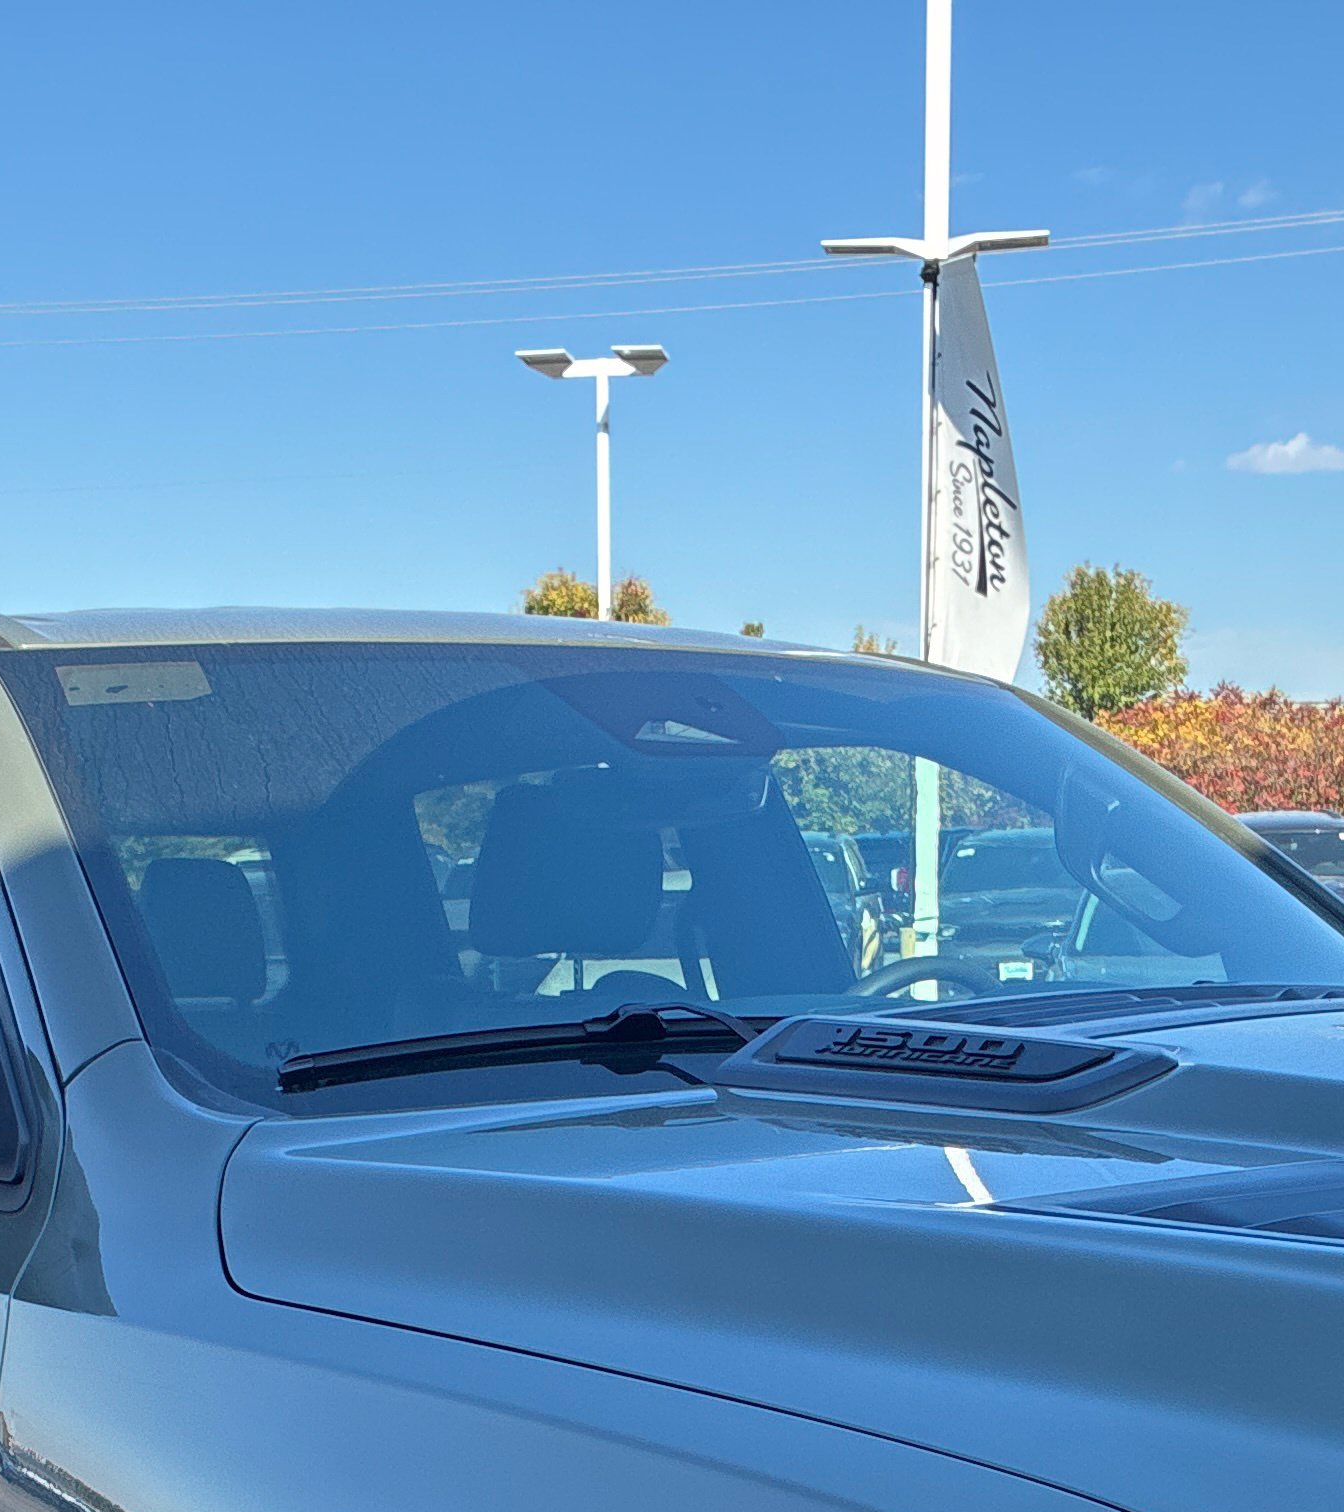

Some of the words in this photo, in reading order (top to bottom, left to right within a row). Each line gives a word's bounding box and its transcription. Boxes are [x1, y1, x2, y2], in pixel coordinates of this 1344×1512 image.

[949, 461, 974, 519] Since
[956, 370, 1017, 593] Napleton
[951, 522, 974, 588] 1931
[832, 1028, 1026, 1059] 1500
